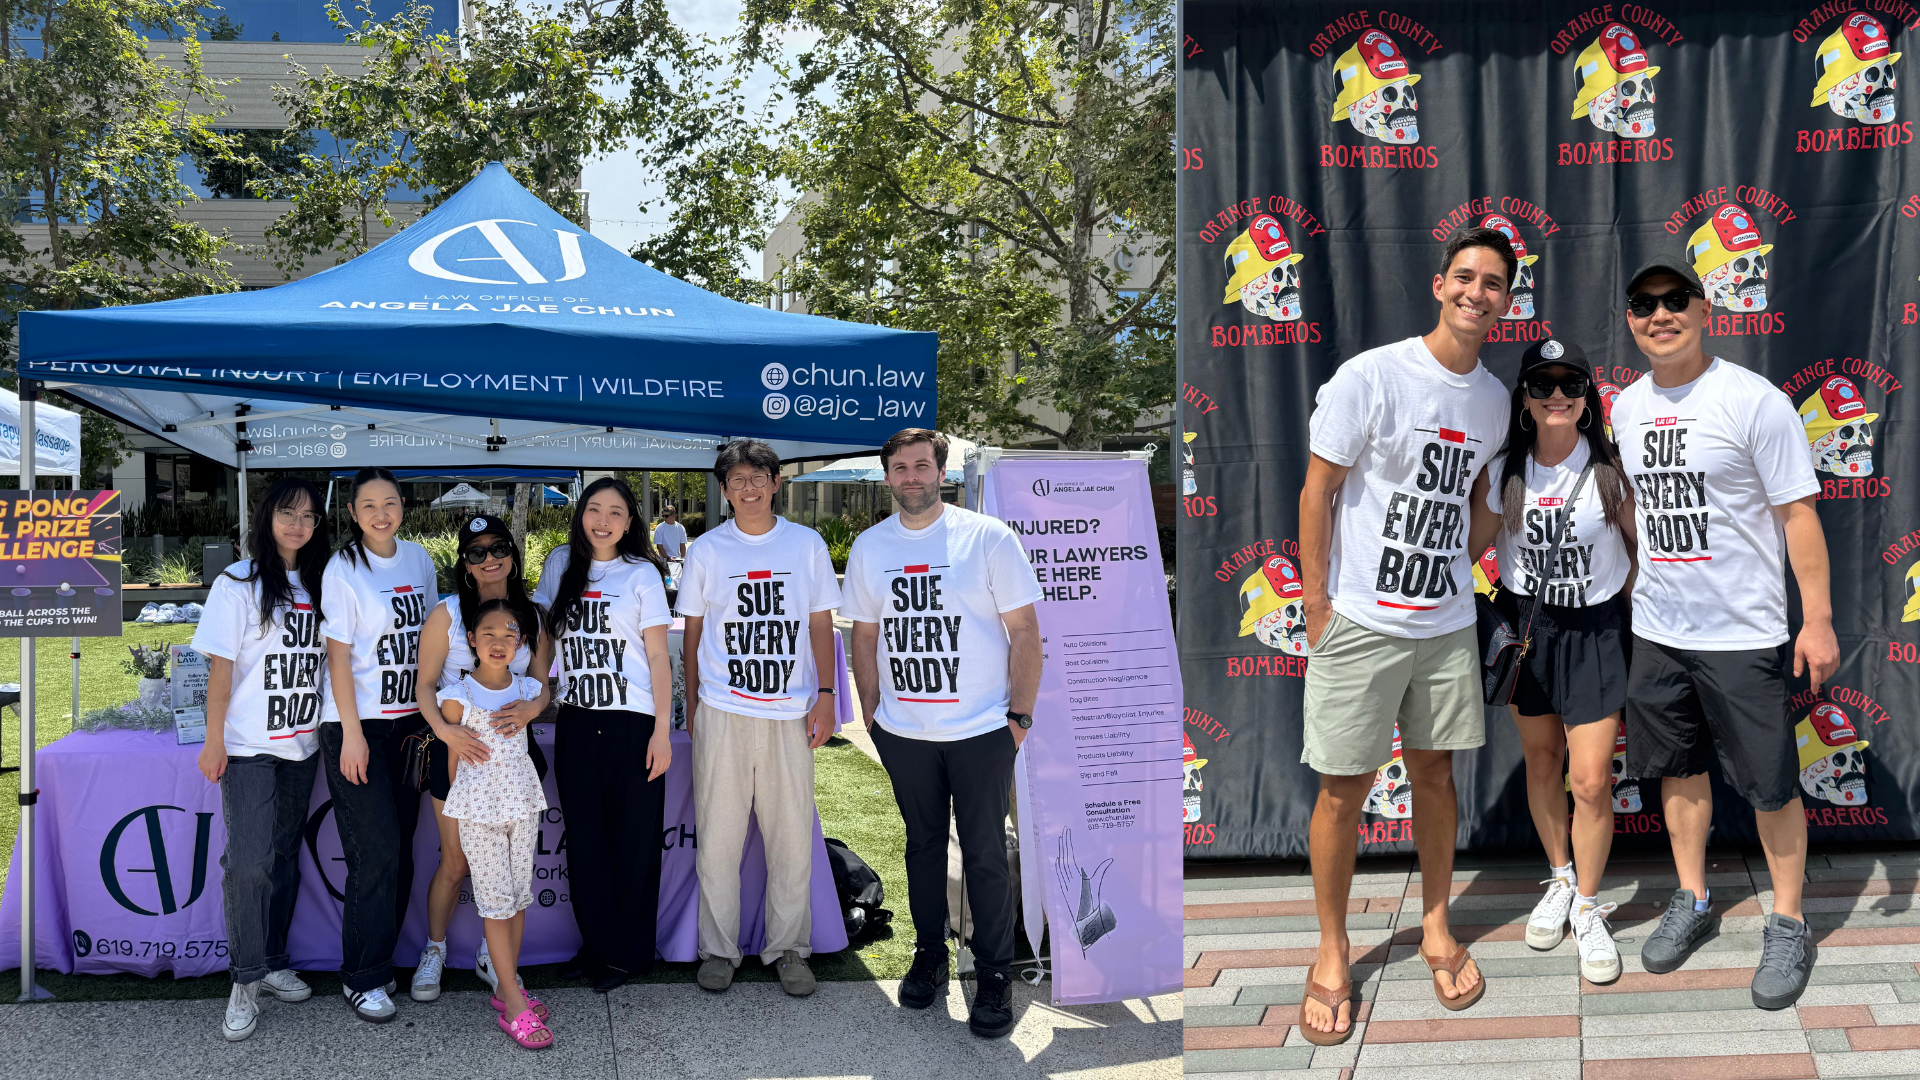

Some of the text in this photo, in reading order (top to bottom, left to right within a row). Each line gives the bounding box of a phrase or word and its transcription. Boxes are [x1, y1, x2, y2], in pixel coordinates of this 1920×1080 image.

[1309, 10, 1443, 58] ORANGE COUNTY
[1550, 3, 1684, 55] ORANGE COUNTY
[1795, 121, 1914, 153] BOMBEROS
[1319, 144, 1439, 169] BOMBEROS
[1557, 138, 1674, 166] BOMBEROS
[1199, 195, 1326, 244] ORANGE COUNTY
[1432, 196, 1561, 242] ORANGE COUNTY
[1664, 185, 1797, 235] ORANGE COUNTY
[319, 301, 676, 317] ANGELA JAE CHUN
[479, 294, 555, 302] OFFICE
[1210, 321, 1322, 348] BOMBEROS
[1482, 320, 1552, 343] BEROS
[1704, 311, 1785, 337] BEROS
[29, 360, 202, 377] PERSONAL
[353, 372, 569, 393] EMPLOYMENT
[591, 377, 725, 398] WILDFIRE
[792, 362, 926, 389] chun.law
[1781, 357, 1903, 398] RANGE COUNTY
[793, 394, 927, 421] @ajc_law
[1642, 428, 1688, 469] SUE
[1416, 442, 1476, 498] SUE
[1633, 471, 1707, 510] EVERY
[1816, 476, 1891, 501] BEROS
[14, 498, 90, 519] PONG
[16, 519, 92, 539] PRIZE
[1525, 507, 1578, 545] SUE
[1645, 511, 1709, 553] BODY
[1053, 545, 1149, 564] LAWYERS
[1214, 538, 1276, 583] ORANGE
[1051, 566, 1102, 582] HERE
[737, 581, 785, 617] SUE
[891, 574, 943, 612] SUE
[1043, 585, 1098, 602] HELP.
[4, 615, 98, 627] THE CUPS TO WIN!
[26, 607, 69, 617] ACROSS
[71, 606, 91, 615] THE
[566, 600, 612, 634] SUE
[282, 611, 322, 648] SUE
[724, 620, 800, 655] EVERY
[883, 615, 962, 653] EVERY
[377, 630, 421, 666] EVE
[561, 636, 627, 672] EVERY
[1078, 640, 1107, 648] Collisions
[889, 657, 960, 693] BODY
[1080, 658, 1109, 666] Collisions
[1225, 656, 1309, 679] BOMBER
[563, 671, 628, 708] BODY
[728, 658, 796, 694] BODY
[1067, 673, 1149, 685] Construction Negligence
[1138, 709, 1165, 718] Injuries
[1830, 685, 1891, 726] COUNTY
[1077, 750, 1134, 760] Products Liability
[1092, 770, 1105, 778] and
[1106, 769, 1118, 777] Fall
[1084, 800, 1116, 809] Schedule
[1085, 807, 1131, 816] Consultation
[1804, 806, 1889, 827] MBEROS
[661, 823, 697, 851] CH
[1357, 819, 1413, 845] MBER
[1612, 813, 1661, 835] EROS
[532, 863, 569, 881] ork
[96, 938, 230, 959] 619.719.575
